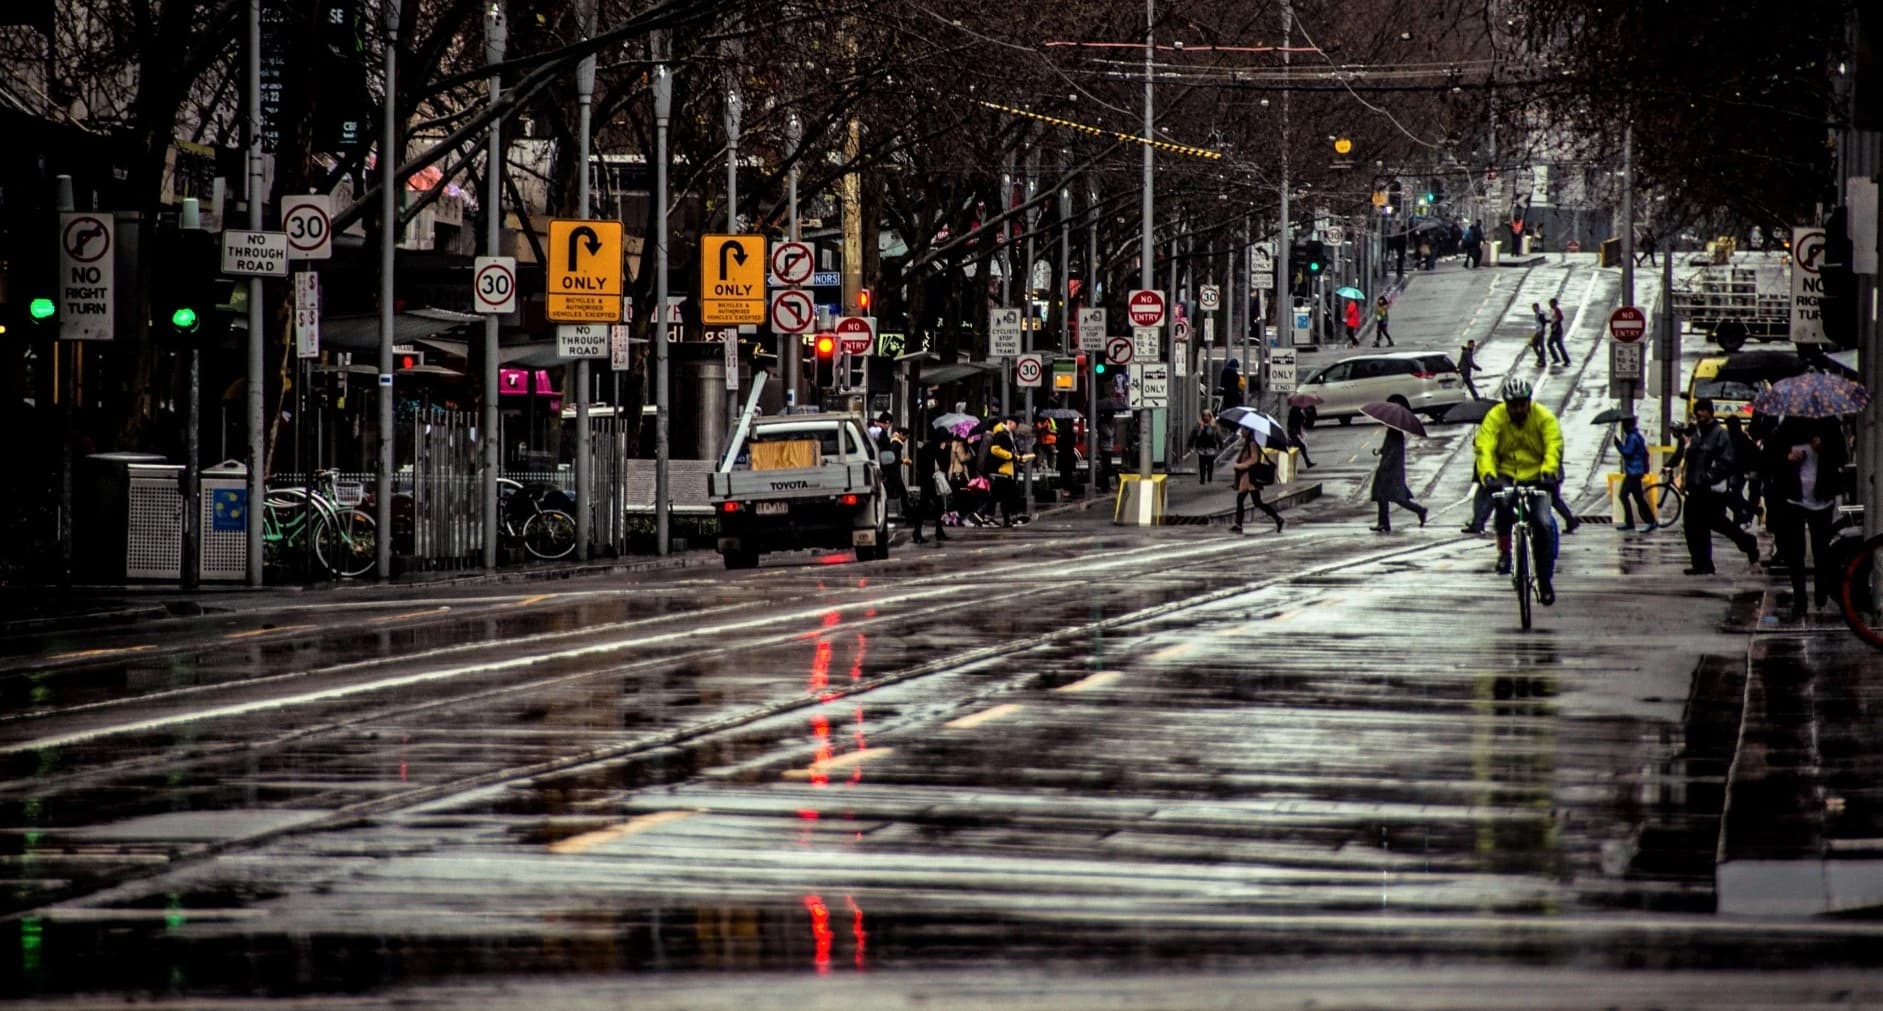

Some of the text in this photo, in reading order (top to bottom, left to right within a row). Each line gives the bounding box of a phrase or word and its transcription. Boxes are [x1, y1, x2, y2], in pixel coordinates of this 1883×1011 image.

[290, 216, 323, 239] 30
[247, 235, 266, 245] NO
[228, 246, 284, 259] THROUGH
[236, 260, 274, 272] ROAD
[72, 267, 101, 284] NO
[482, 275, 509, 295] 30
[562, 276, 607, 290] ONLY
[65, 287, 107, 299] RIGHT
[714, 284, 752, 296] ONLY
[1140, 295, 1152, 304] NO
[1204, 293, 1216, 302] 30
[1796, 295, 1818, 306] RIG
[67, 303, 106, 314] TURN
[1134, 313, 1159, 321] ENTRY
[1622, 311, 1634, 320] NO
[1798, 309, 1824, 320] TUR
[576, 326, 591, 334] NO
[1614, 328, 1640, 337] ENTRY
[561, 336, 606, 345] THROUGH
[568, 346, 599, 355] ROAD
[843, 342, 867, 350] NTRY
[1022, 365, 1038, 376] 30
[1271, 370, 1293, 379] ONLY
[1145, 385, 1165, 393] ONLY
[770, 481, 808, 490] TOYOTA
